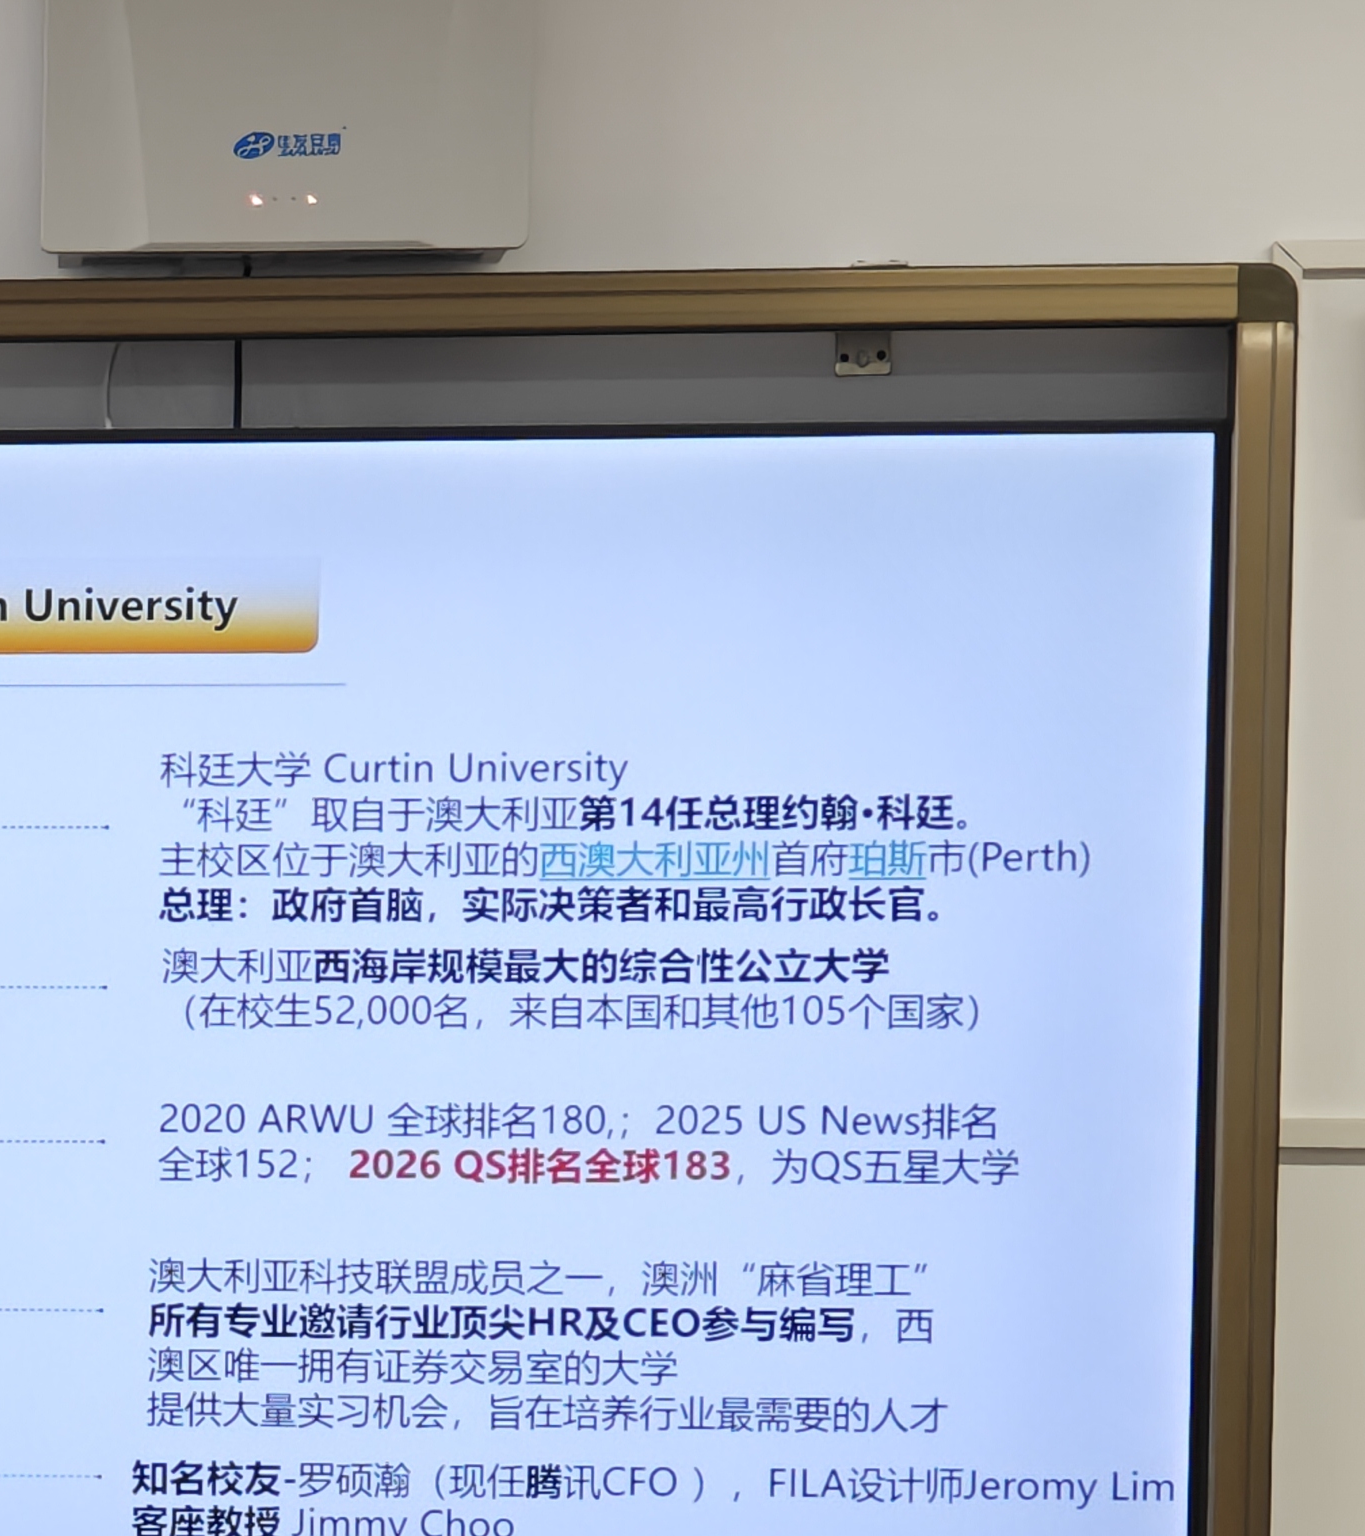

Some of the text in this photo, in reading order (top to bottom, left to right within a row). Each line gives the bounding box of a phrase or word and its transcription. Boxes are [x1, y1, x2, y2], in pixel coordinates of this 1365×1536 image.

[25, 586, 239, 632] University
[159, 750, 629, 791] 科廷大学 Curtin University
[162, 946, 891, 985] 澳大利亚西海岸规模最大的综合性公立大学
[159, 1102, 246, 1135] 2020
[257, 1103, 374, 1135] ARWU
[758, 1104, 807, 1136] US
[821, 1102, 998, 1141] News排名
[348, 1148, 442, 1180] 2026
[147, 1346, 679, 1387] 澳区唯一拥有证券交易室的大学
[1111, 1470, 1176, 1502] Lim
